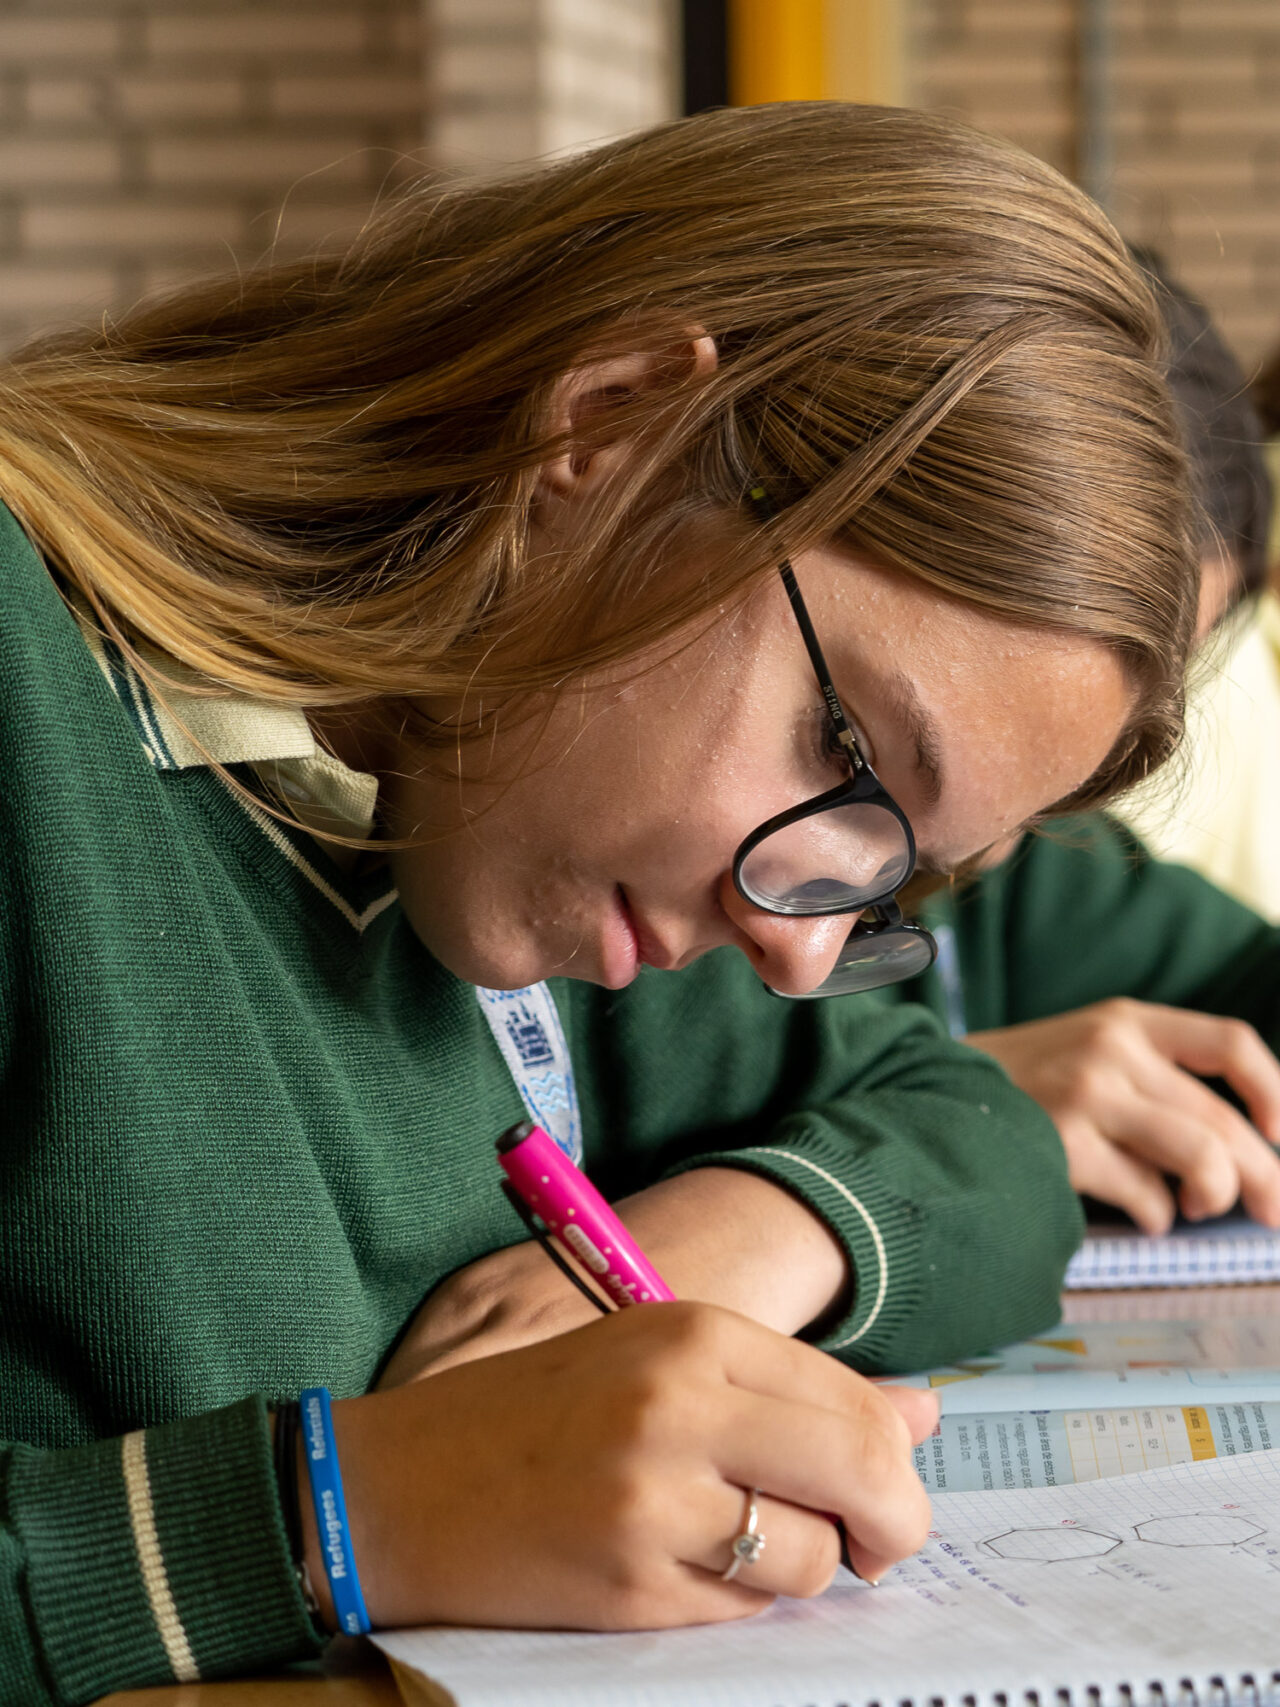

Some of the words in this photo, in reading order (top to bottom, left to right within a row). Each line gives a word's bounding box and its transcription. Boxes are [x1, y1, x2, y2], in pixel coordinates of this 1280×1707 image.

[933, 1445, 945, 1458] área
[1042, 1452, 1053, 1460] de
[934, 1459, 945, 1467] de
[1044, 1460, 1055, 1476] estos
[936, 1474, 948, 1488] zona
[320, 1488, 348, 1580] Refugees
